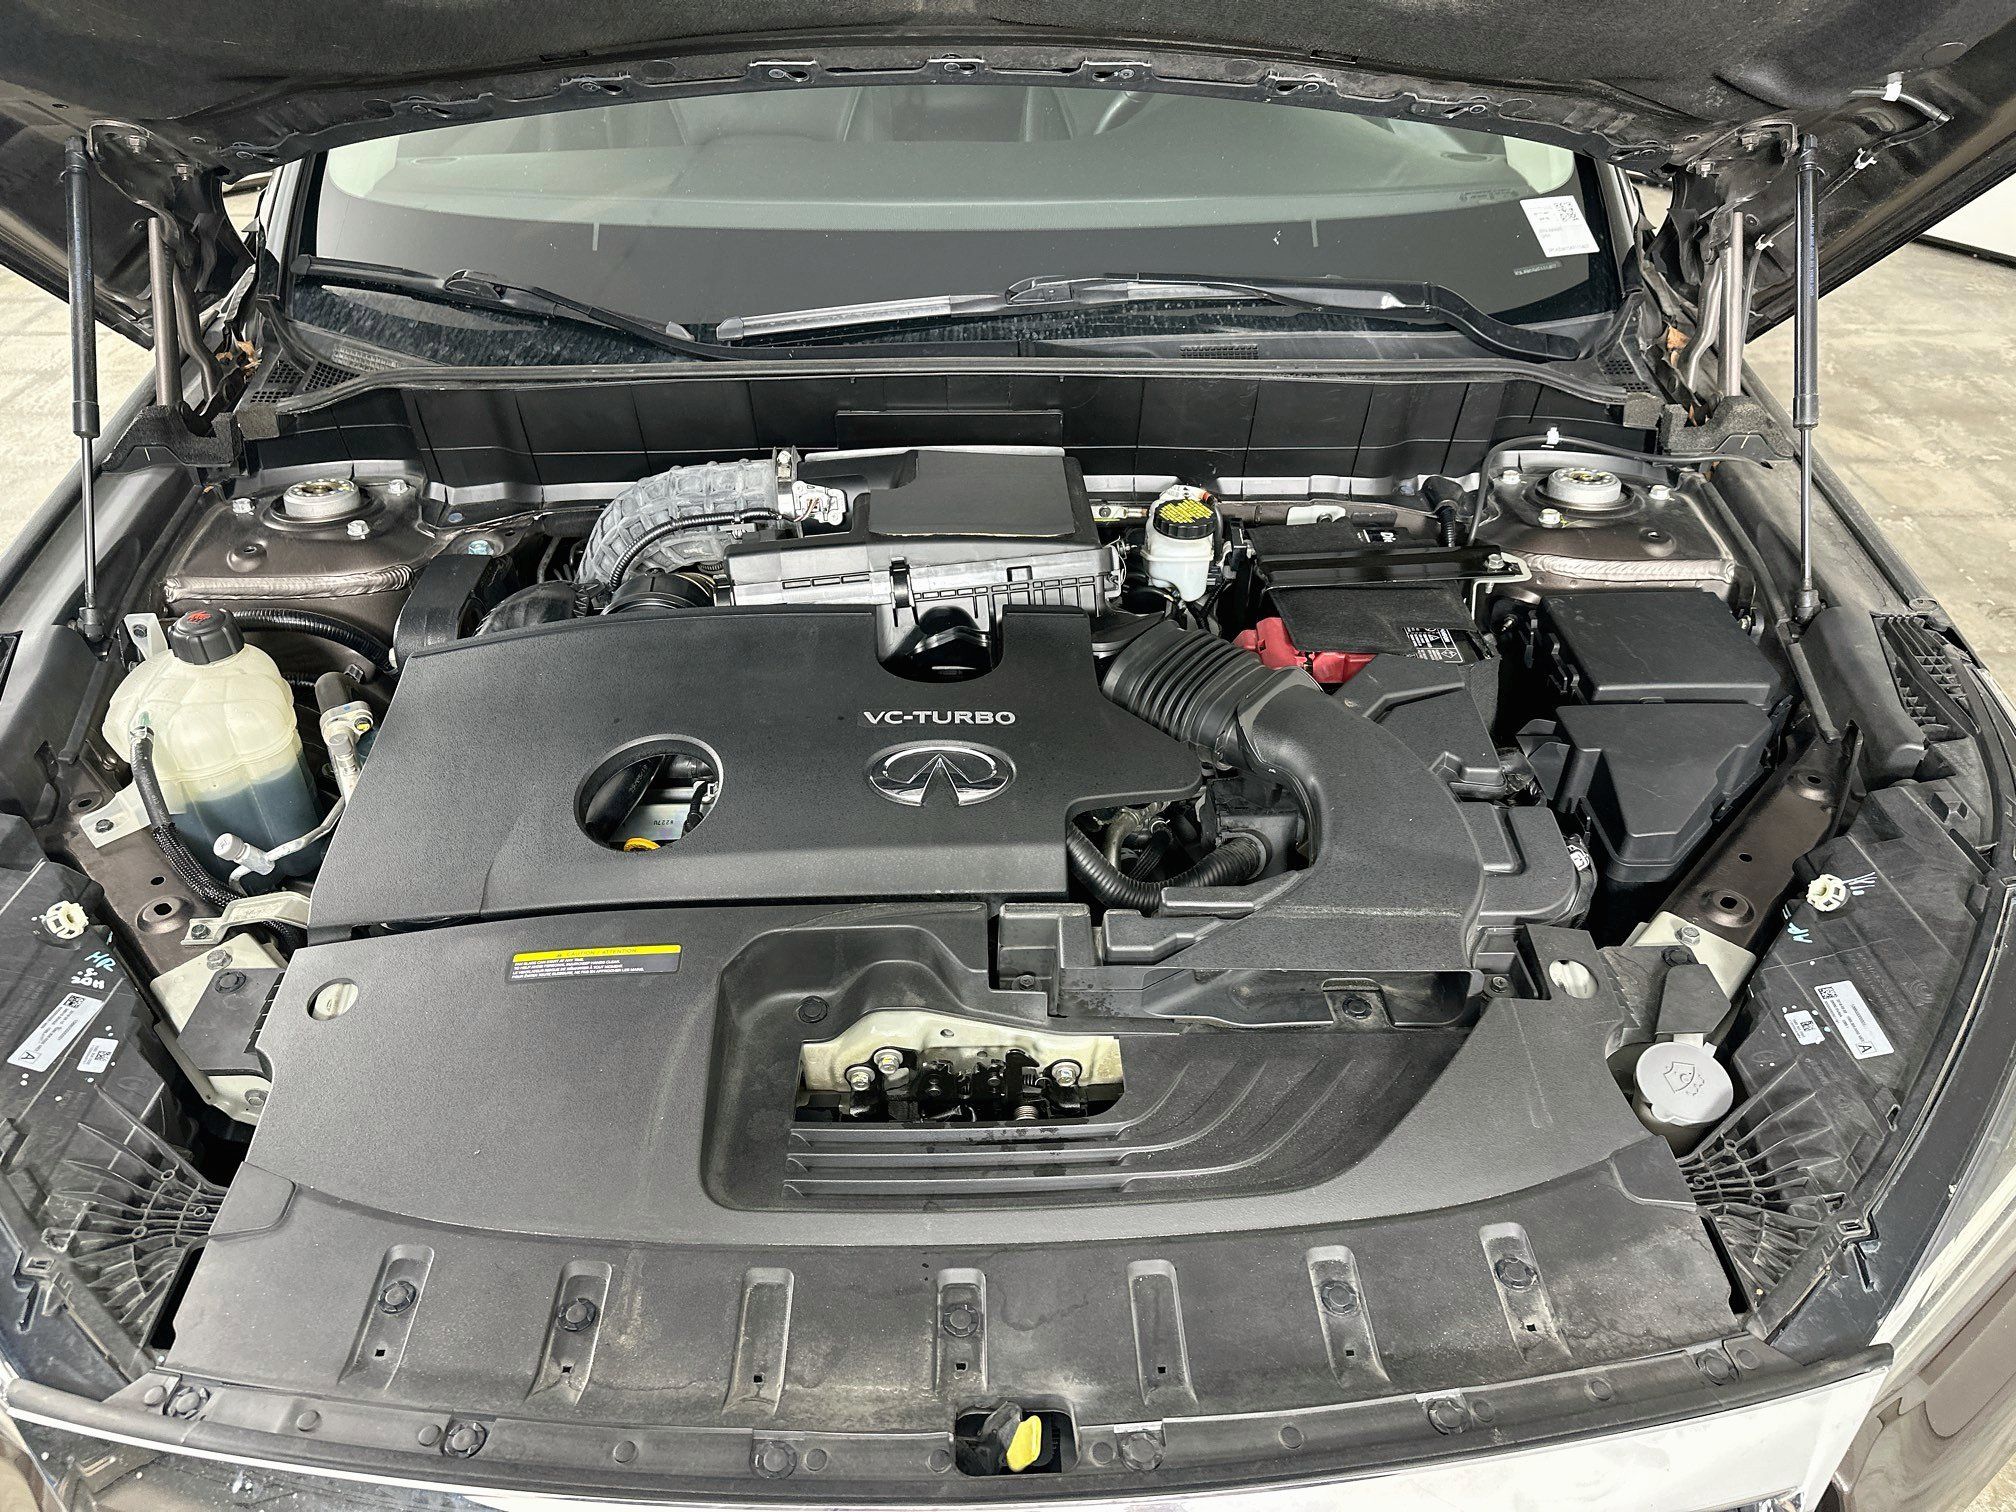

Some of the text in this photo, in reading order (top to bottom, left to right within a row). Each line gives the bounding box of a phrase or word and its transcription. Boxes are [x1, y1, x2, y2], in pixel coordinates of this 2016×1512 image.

[863, 711, 1016, 725] VC-TURBO
[1858, 1044, 1872, 1053] A
[20, 1051, 35, 1060] A
